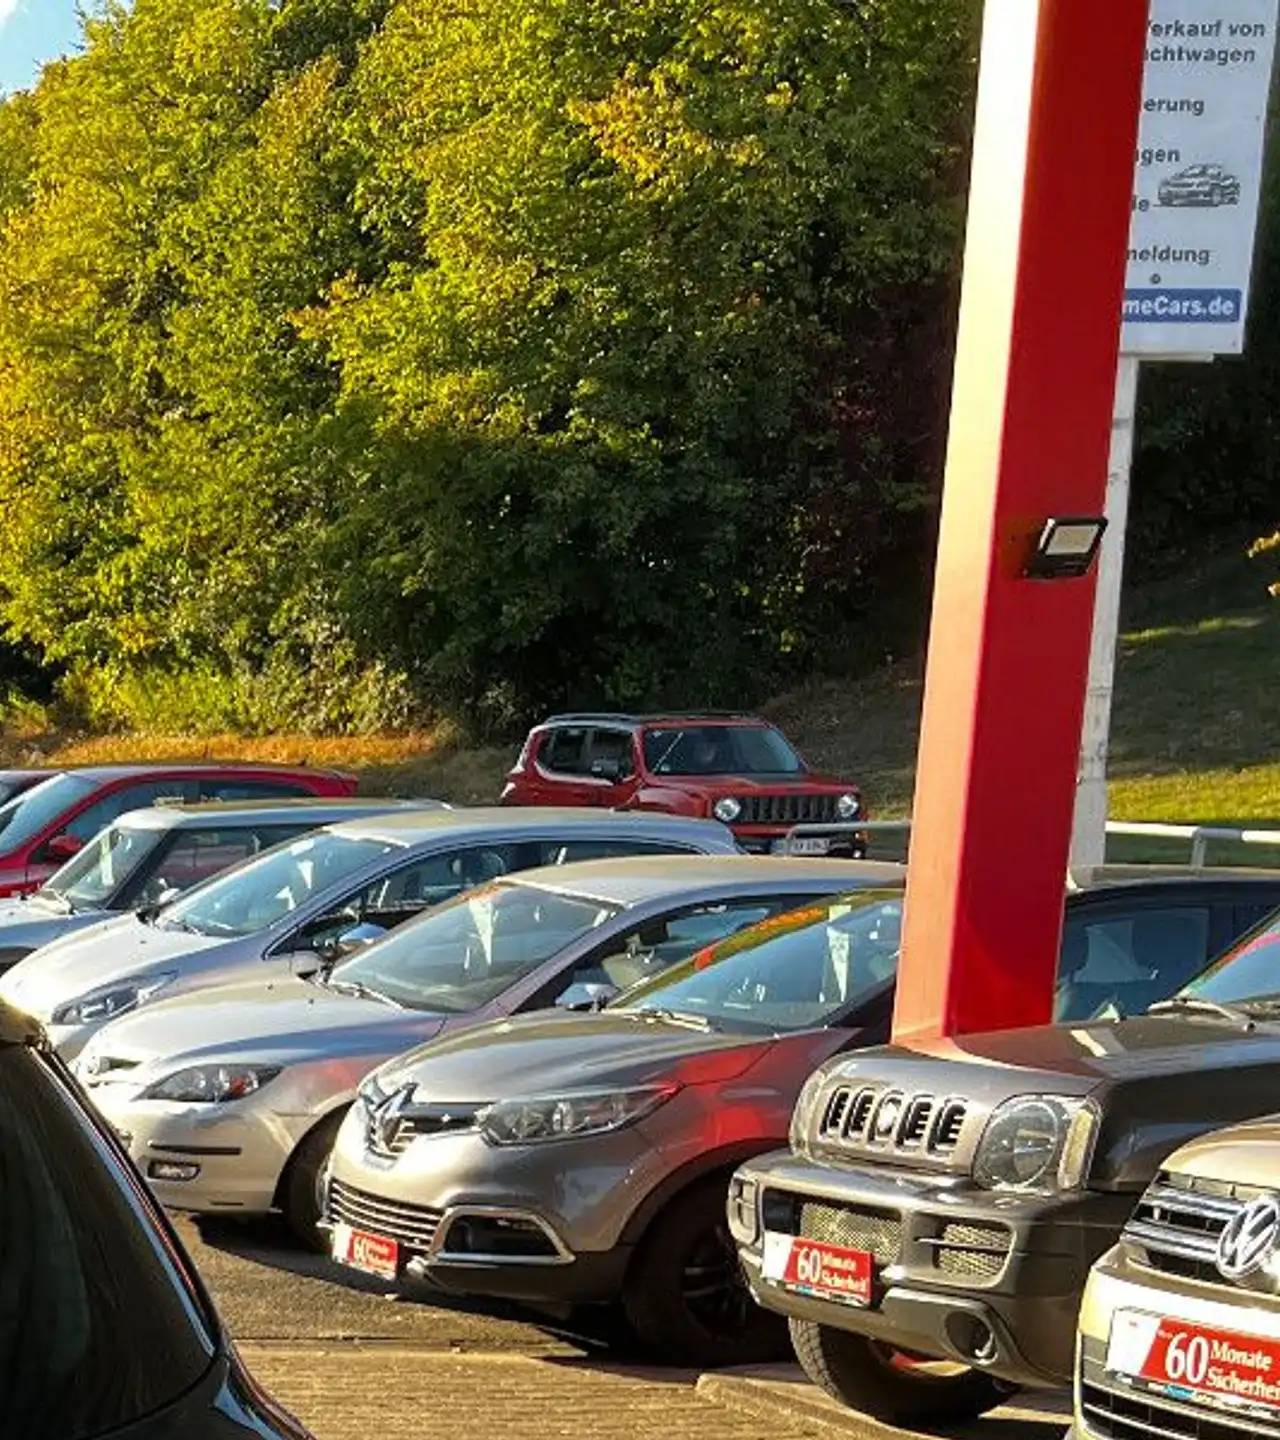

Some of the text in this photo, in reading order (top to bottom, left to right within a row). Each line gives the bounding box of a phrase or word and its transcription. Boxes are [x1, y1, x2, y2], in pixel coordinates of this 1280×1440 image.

[1148, 20, 1265, 38] erkauf von
[1146, 46, 1256, 66] chtwagen
[797, 1247, 821, 1284] 60
[1165, 1332, 1209, 1384] 60
[1210, 1339, 1273, 1371] Monate
